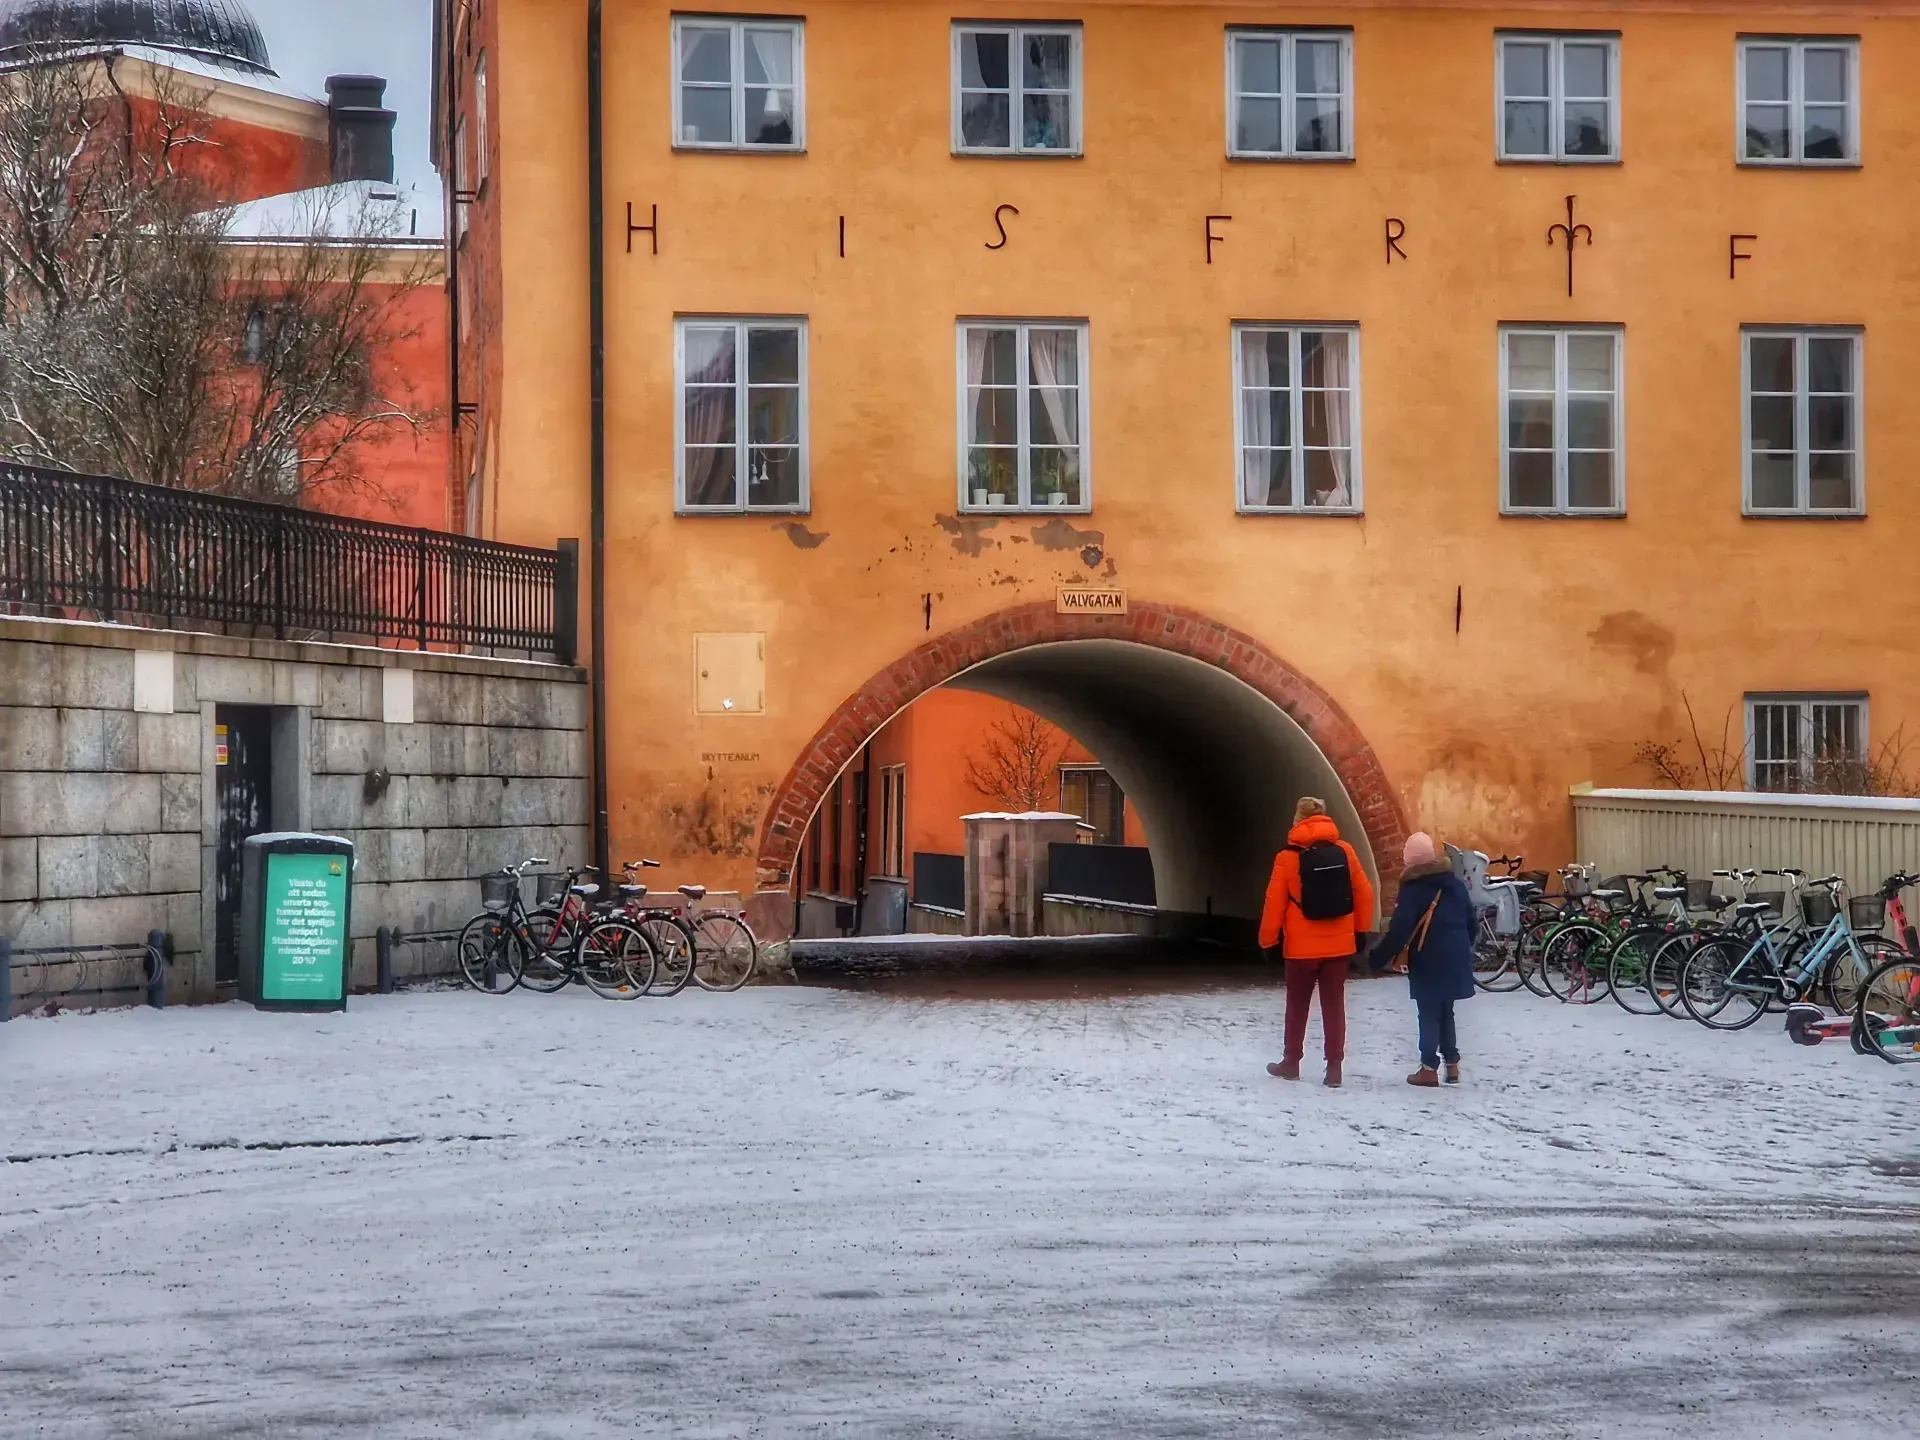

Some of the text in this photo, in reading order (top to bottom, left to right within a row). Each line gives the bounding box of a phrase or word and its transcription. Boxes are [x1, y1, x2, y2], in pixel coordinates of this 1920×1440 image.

[626, 201, 658, 256] H
[984, 203, 1021, 251] S
[1205, 215, 1233, 265] F
[1384, 216, 1409, 265] R
[1729, 234, 1758, 280] F
[1062, 593, 1122, 608] VALVGATAN
[288, 889, 300, 897] att
[283, 899, 312, 907] smarta
[276, 908, 302, 916] tunnor
[276, 918, 335, 928] har det synliga
[278, 946, 331, 955] minskat med
